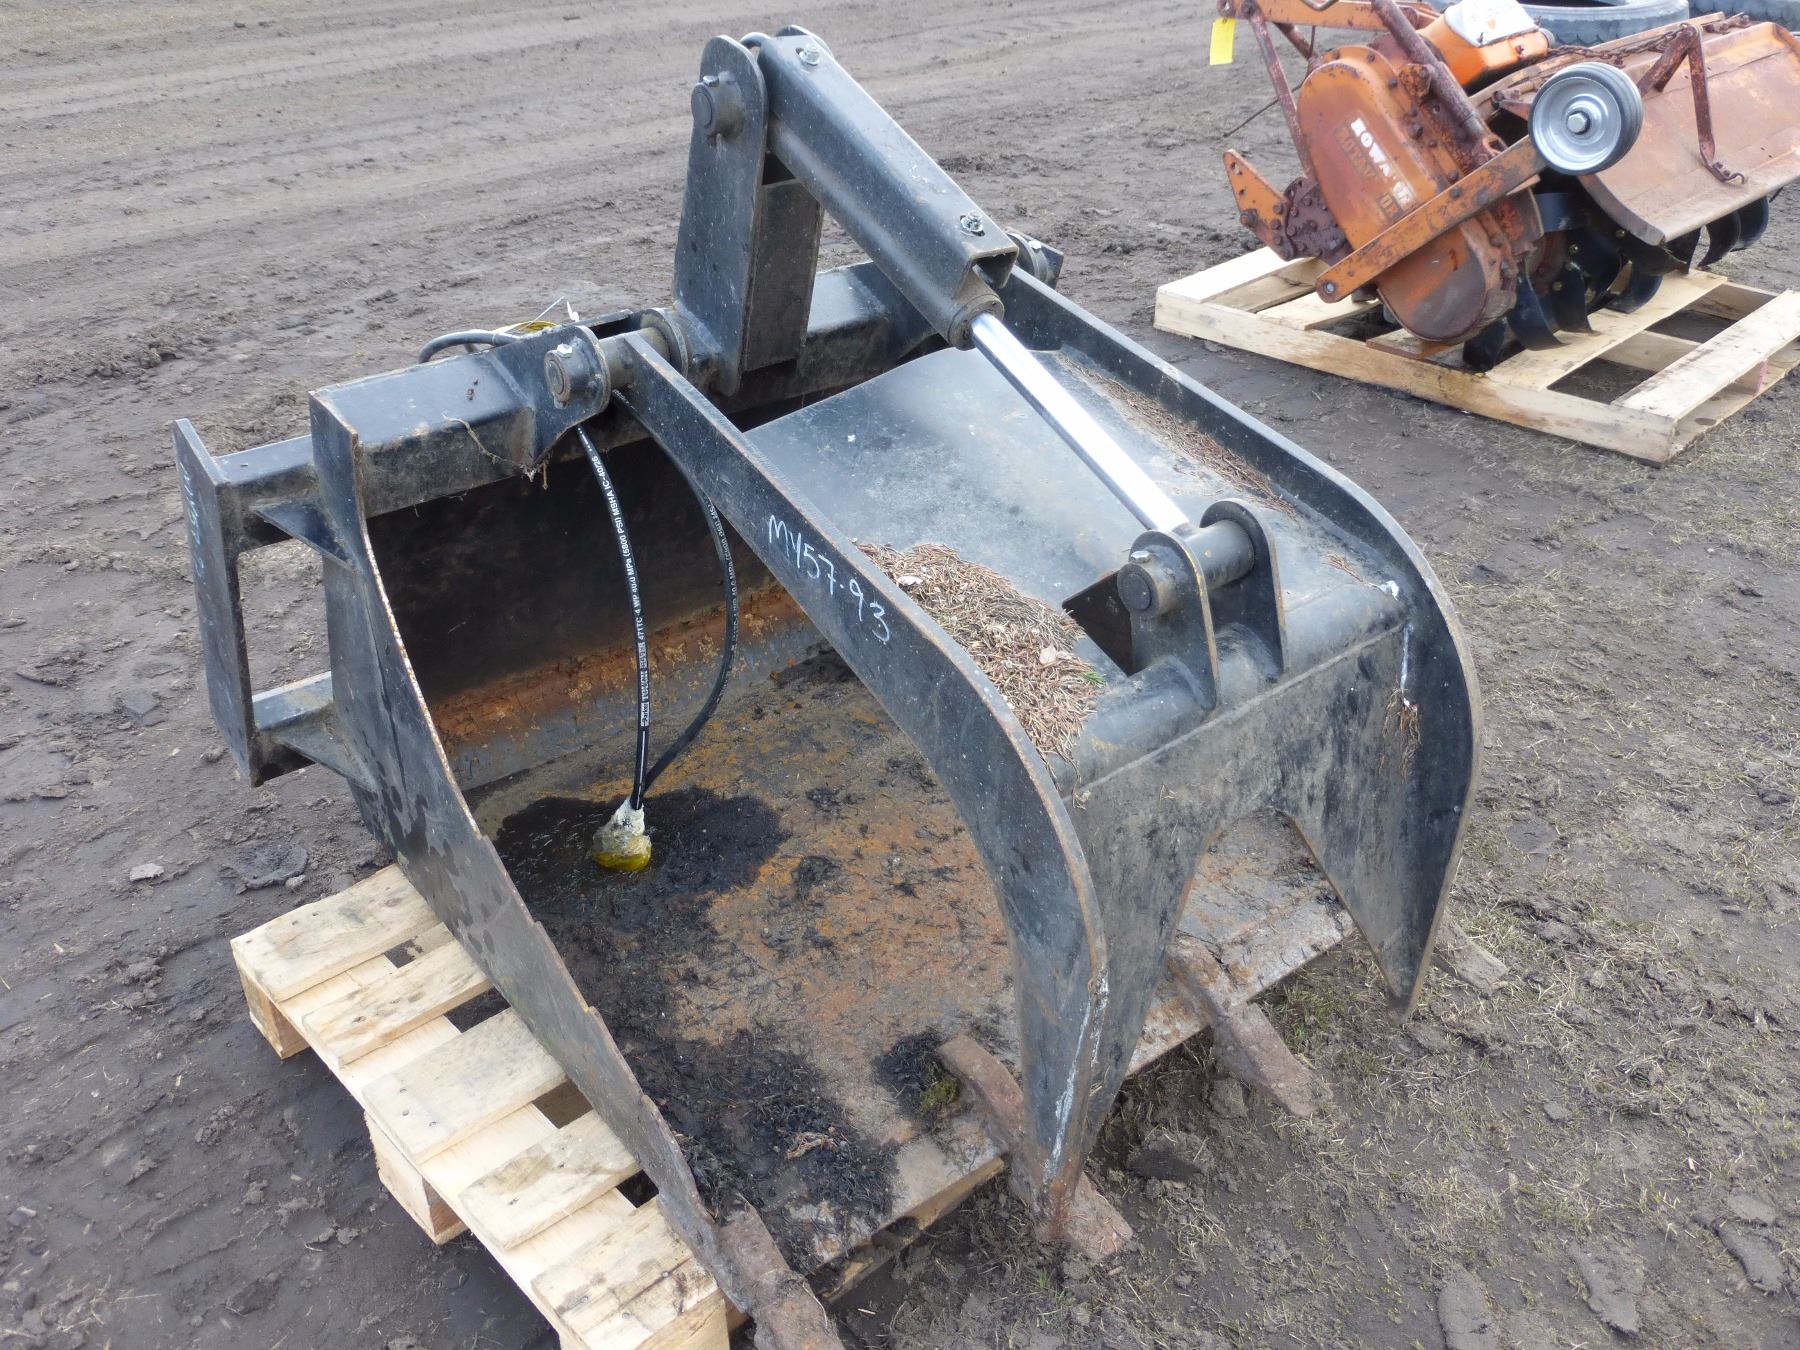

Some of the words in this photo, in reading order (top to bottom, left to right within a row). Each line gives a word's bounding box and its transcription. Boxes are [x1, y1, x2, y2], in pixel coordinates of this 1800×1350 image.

[591, 455, 611, 490] IC-40/26
[606, 490, 621, 516] MSHA
[614, 517, 625, 534] PSI)
[620, 535, 631, 557] (5800
[625, 558, 635, 576] MPa
